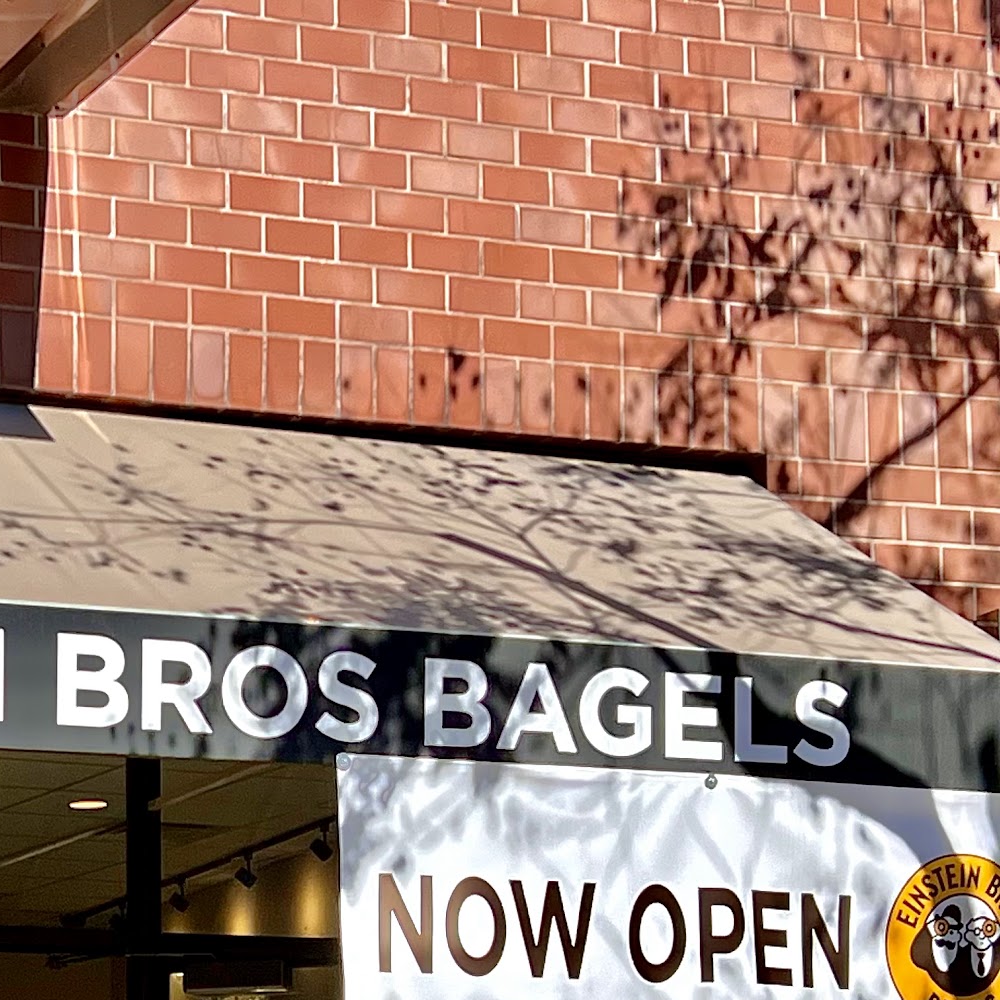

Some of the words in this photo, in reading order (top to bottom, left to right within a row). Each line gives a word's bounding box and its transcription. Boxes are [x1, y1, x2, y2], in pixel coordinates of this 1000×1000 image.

[56, 631, 380, 743] BROS
[424, 657, 850, 767] BAGELS
[377, 872, 597, 980] NOW
[628, 883, 851, 990] OPEN
[896, 864, 981, 929] EINSTEIN
